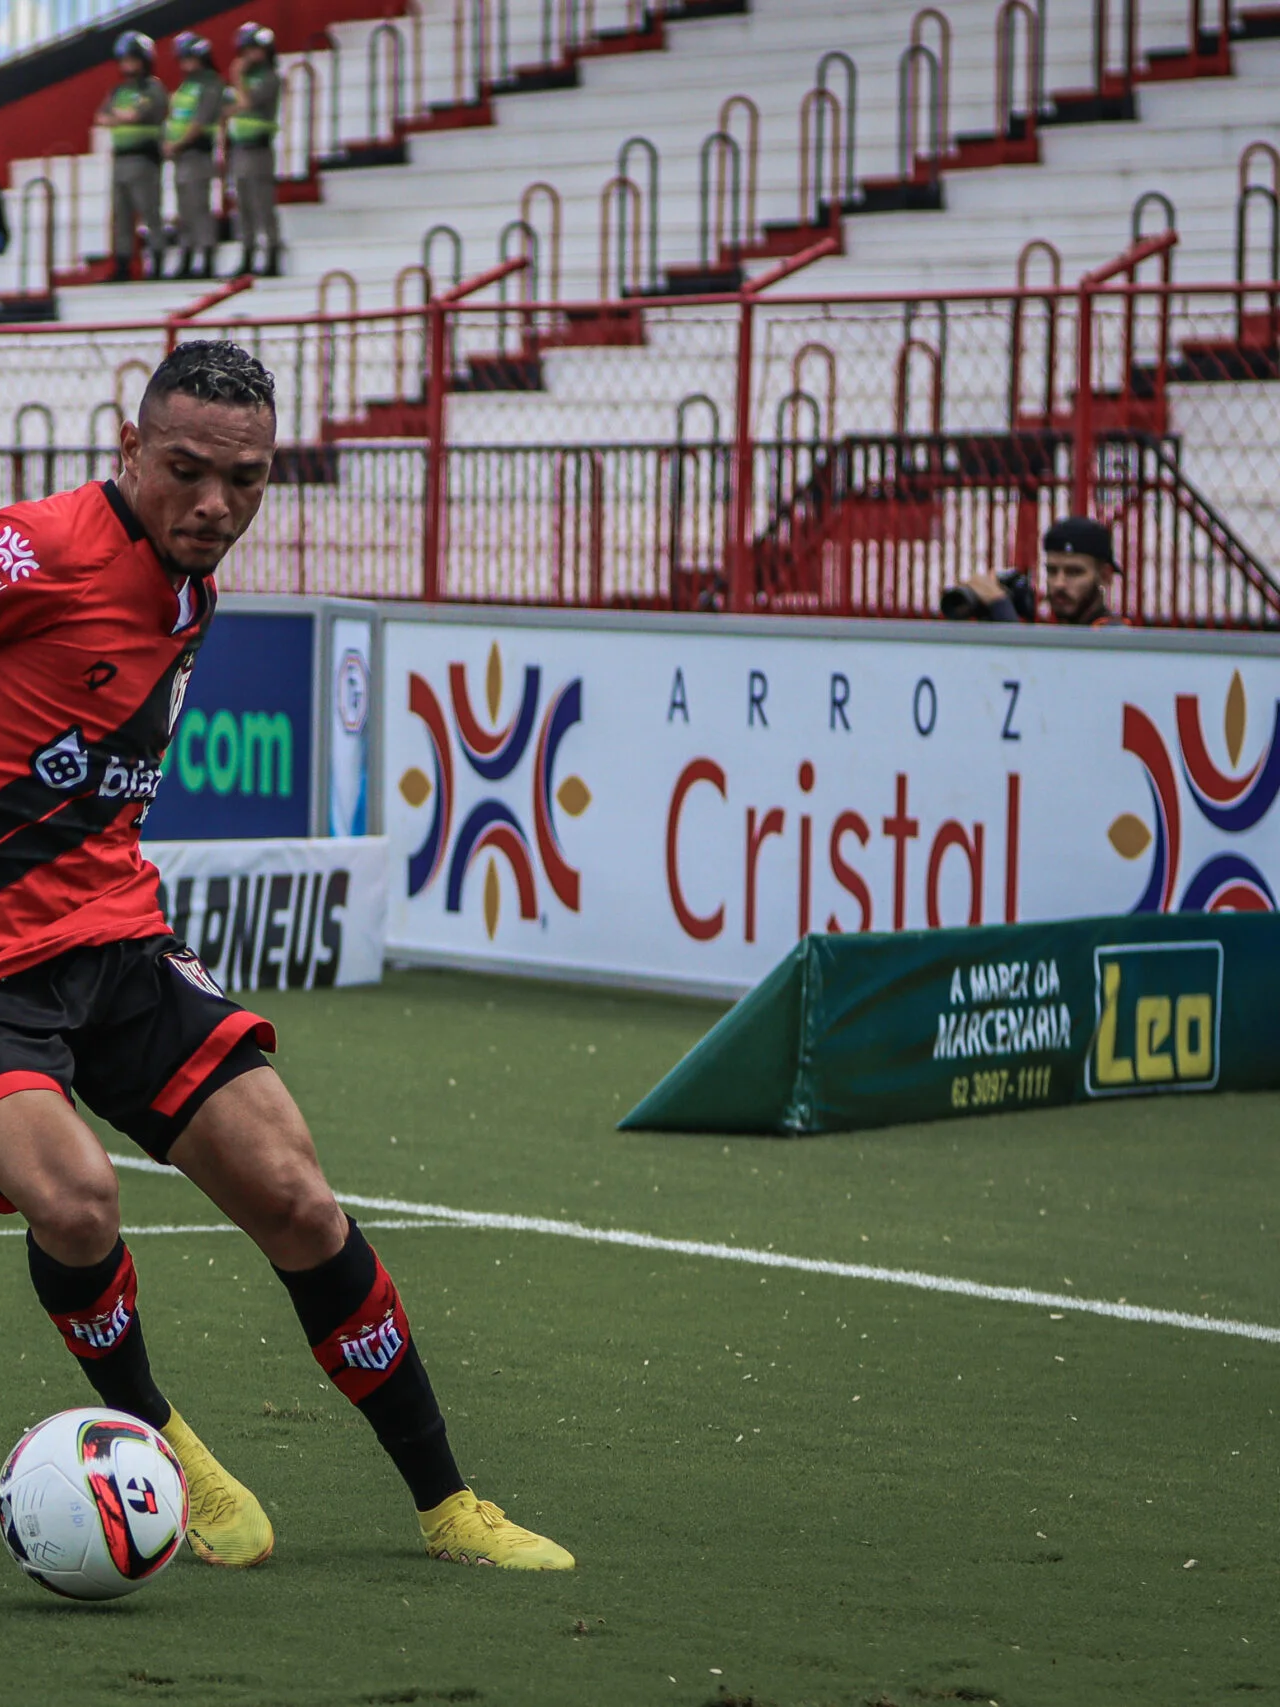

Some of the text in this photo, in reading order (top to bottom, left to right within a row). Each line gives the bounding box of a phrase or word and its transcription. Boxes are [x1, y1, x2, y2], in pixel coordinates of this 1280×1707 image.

[666, 666, 1021, 741] ARROZ
[665, 756, 1022, 944] Cristal
[950, 966, 966, 1005] A
[970, 961, 1029, 1002] MARCA
[933, 1002, 1071, 1061] MARCENARIA
[1096, 961, 1213, 1085] Leo
[70, 1300, 130, 1348] ACG
[340, 1316, 403, 1370] ACG
